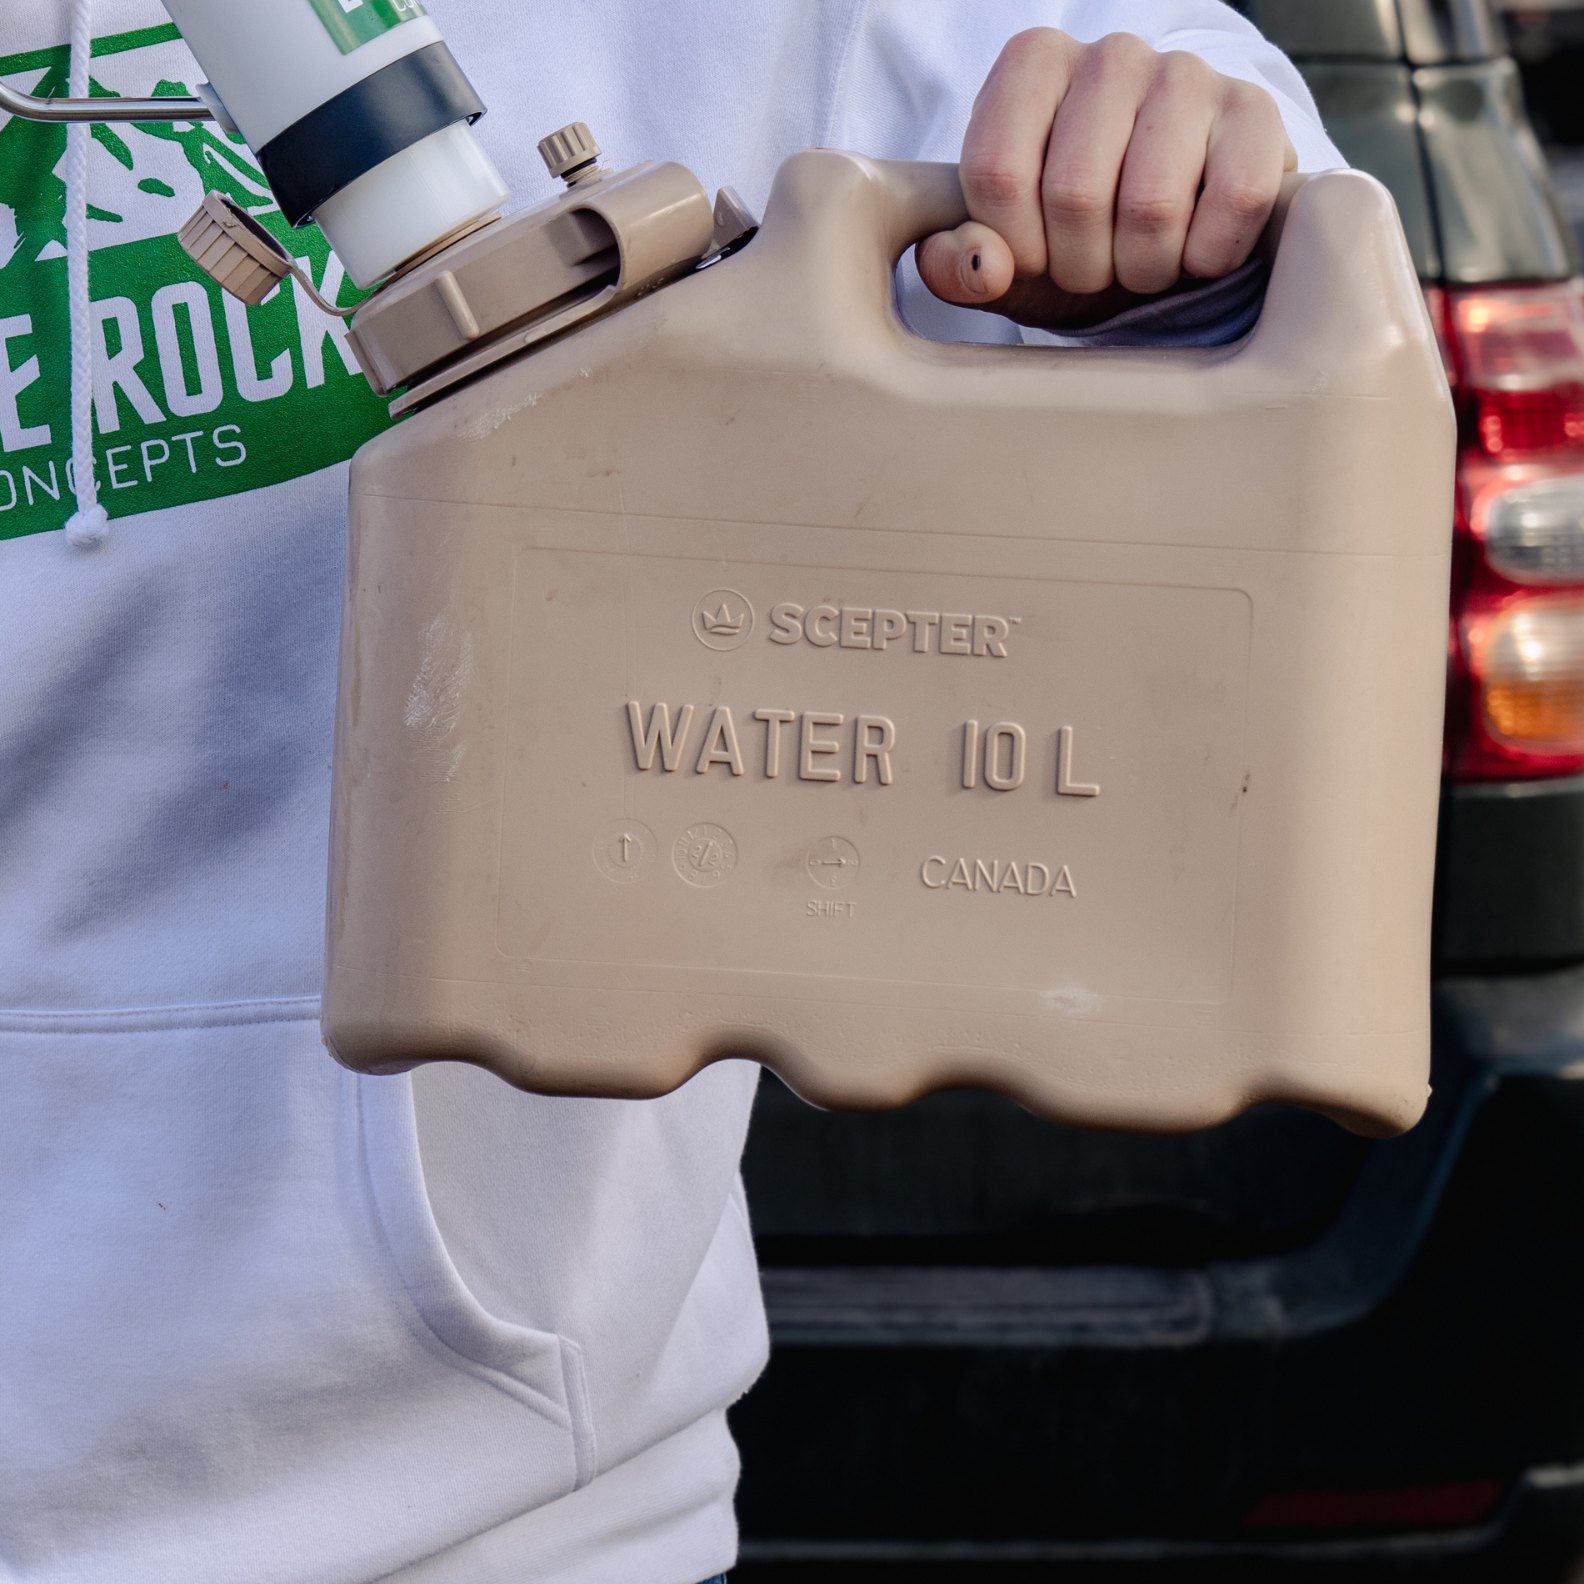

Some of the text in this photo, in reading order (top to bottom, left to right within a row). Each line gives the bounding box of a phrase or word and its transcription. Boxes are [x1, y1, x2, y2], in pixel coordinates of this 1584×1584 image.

[86, 250, 365, 435] ROCK
[626, 700, 1101, 798] WATER 10 L
[806, 900, 857, 917] SHIFT
[921, 855, 1077, 899] CANADA
